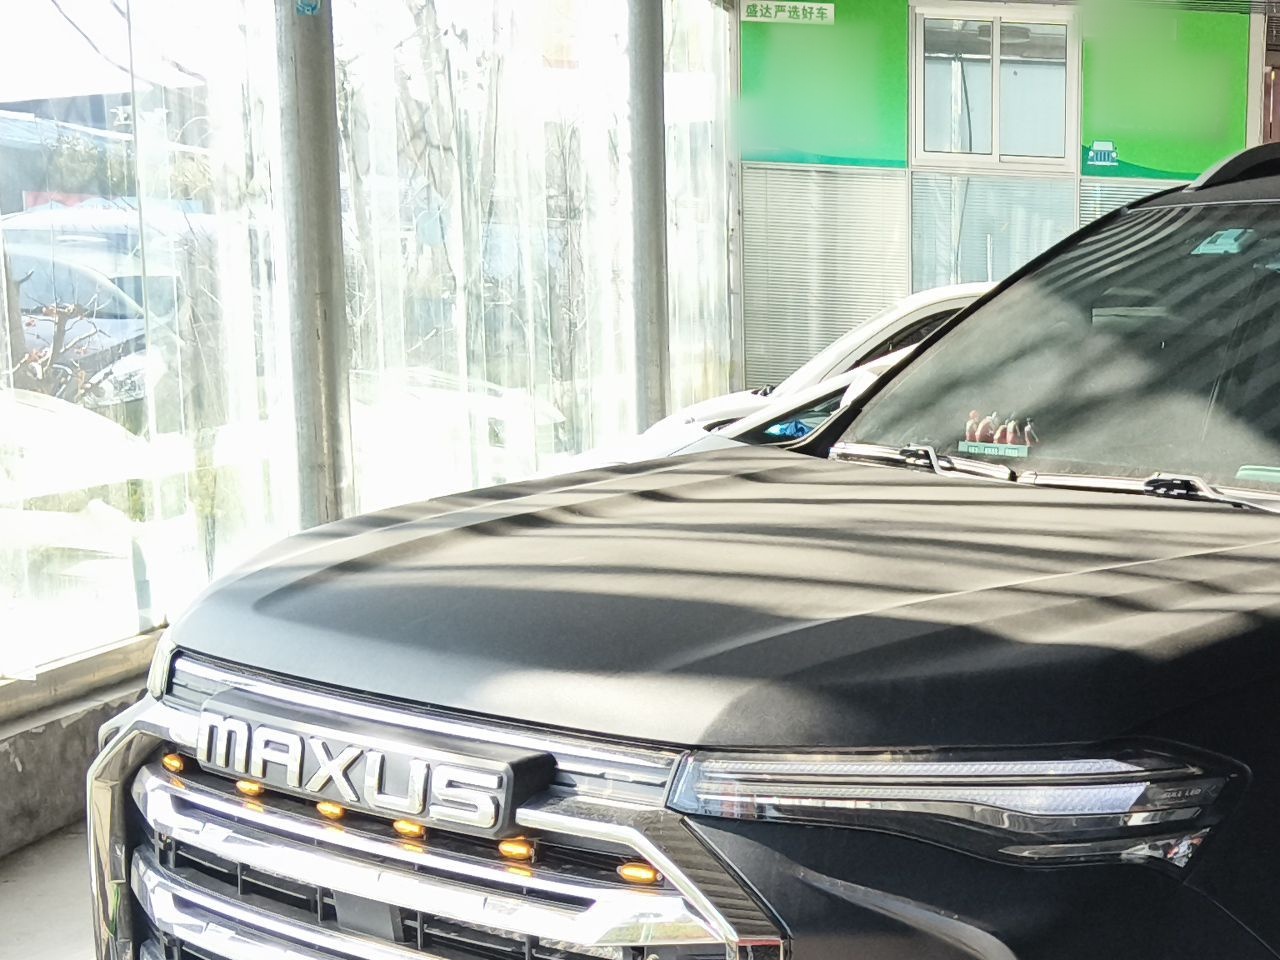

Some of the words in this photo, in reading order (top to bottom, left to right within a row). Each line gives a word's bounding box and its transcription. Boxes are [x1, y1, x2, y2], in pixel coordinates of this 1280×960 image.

[745, 3, 829, 20] 盛达严选好车
[200, 711, 503, 829] MAXUS
